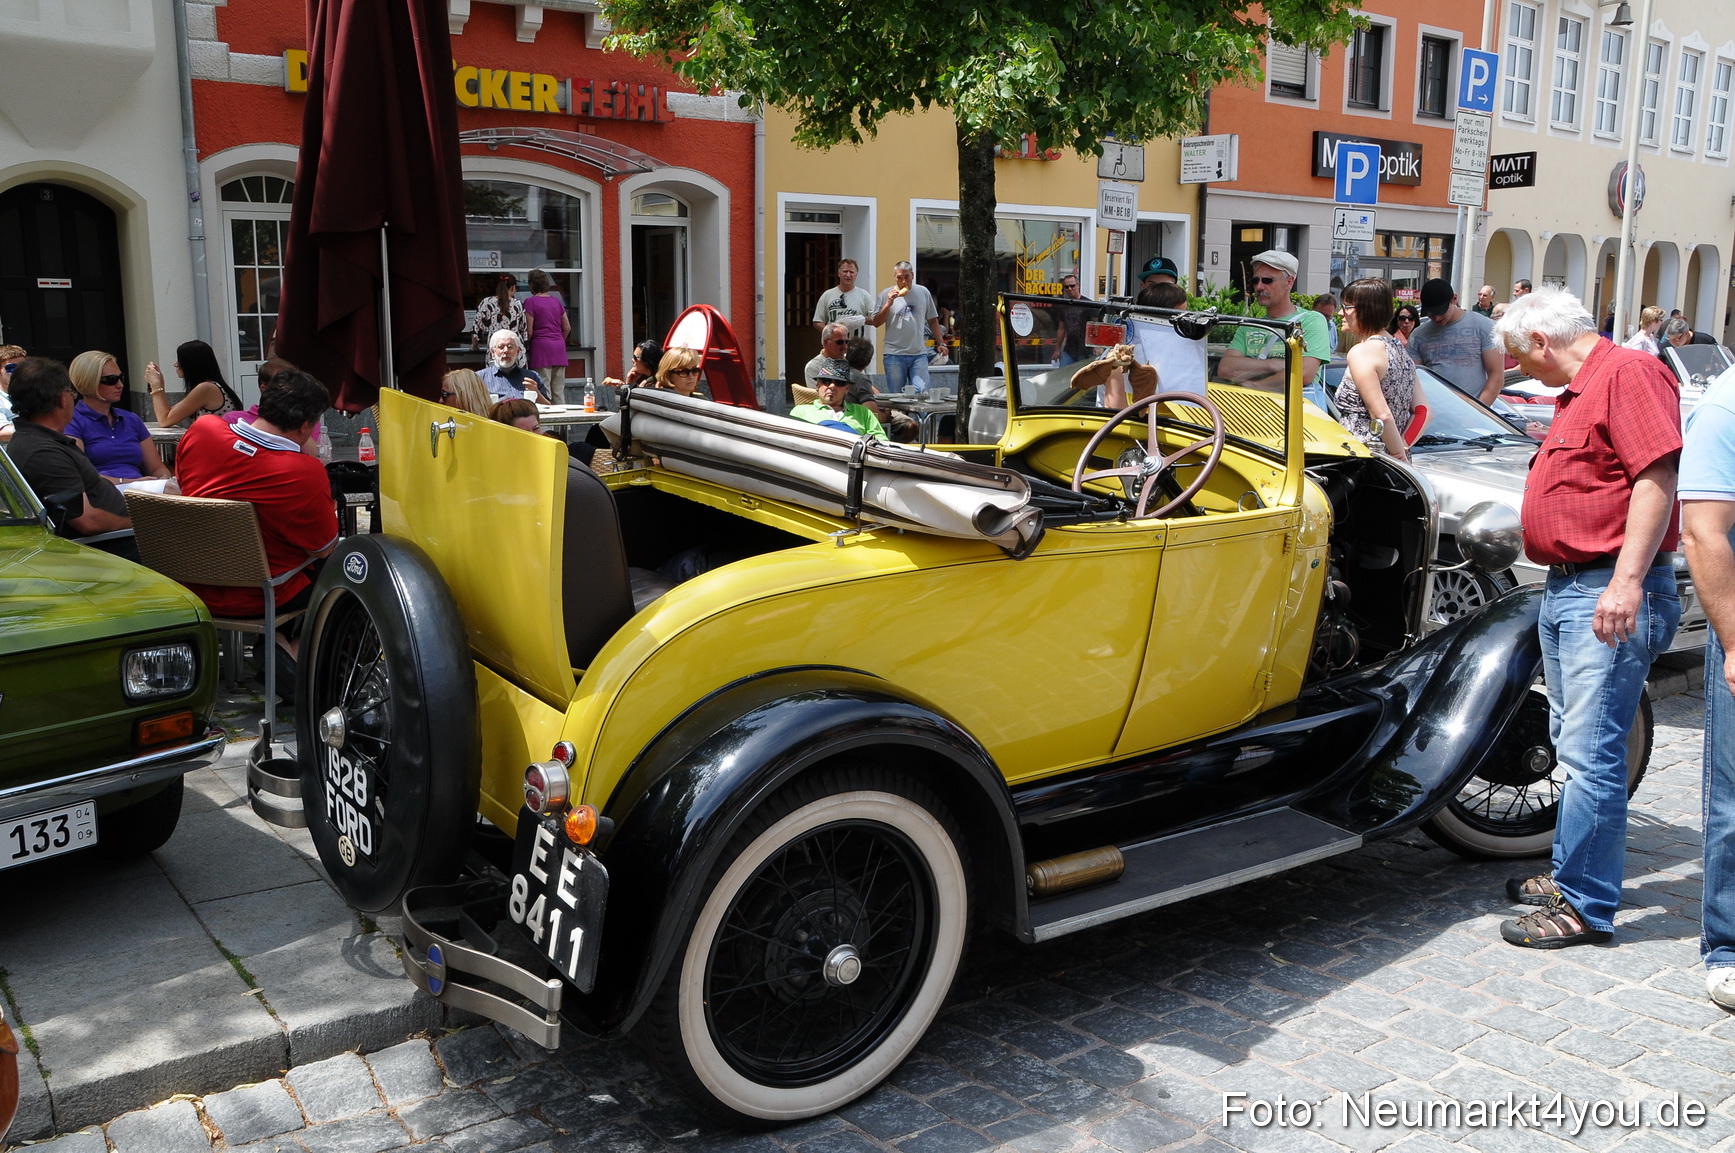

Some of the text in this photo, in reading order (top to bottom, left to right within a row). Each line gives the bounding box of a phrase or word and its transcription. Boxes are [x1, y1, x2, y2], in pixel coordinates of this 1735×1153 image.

[452, 58, 561, 114] CKER
[1467, 57, 1489, 102] P
[1457, 125, 1489, 137] Parkschein
[1475, 119, 1485, 127] mit
[1459, 136, 1485, 148] werktags
[1345, 151, 1370, 196] P
[1492, 156, 1531, 173] MATT
[1495, 173, 1524, 186] optik
[1104, 193, 1125, 204] Reserviert
[1026, 269, 1045, 281] DER
[1026, 281, 1063, 295] BÄCKER
[346, 556, 364, 576] Ford
[328, 746, 368, 808] 1928
[326, 780, 372, 856] FORD
[9, 807, 90, 859] 133 04
[77, 829, 93, 840] 09
[340, 839, 353, 863] GB
[509, 873, 585, 980] 8411
